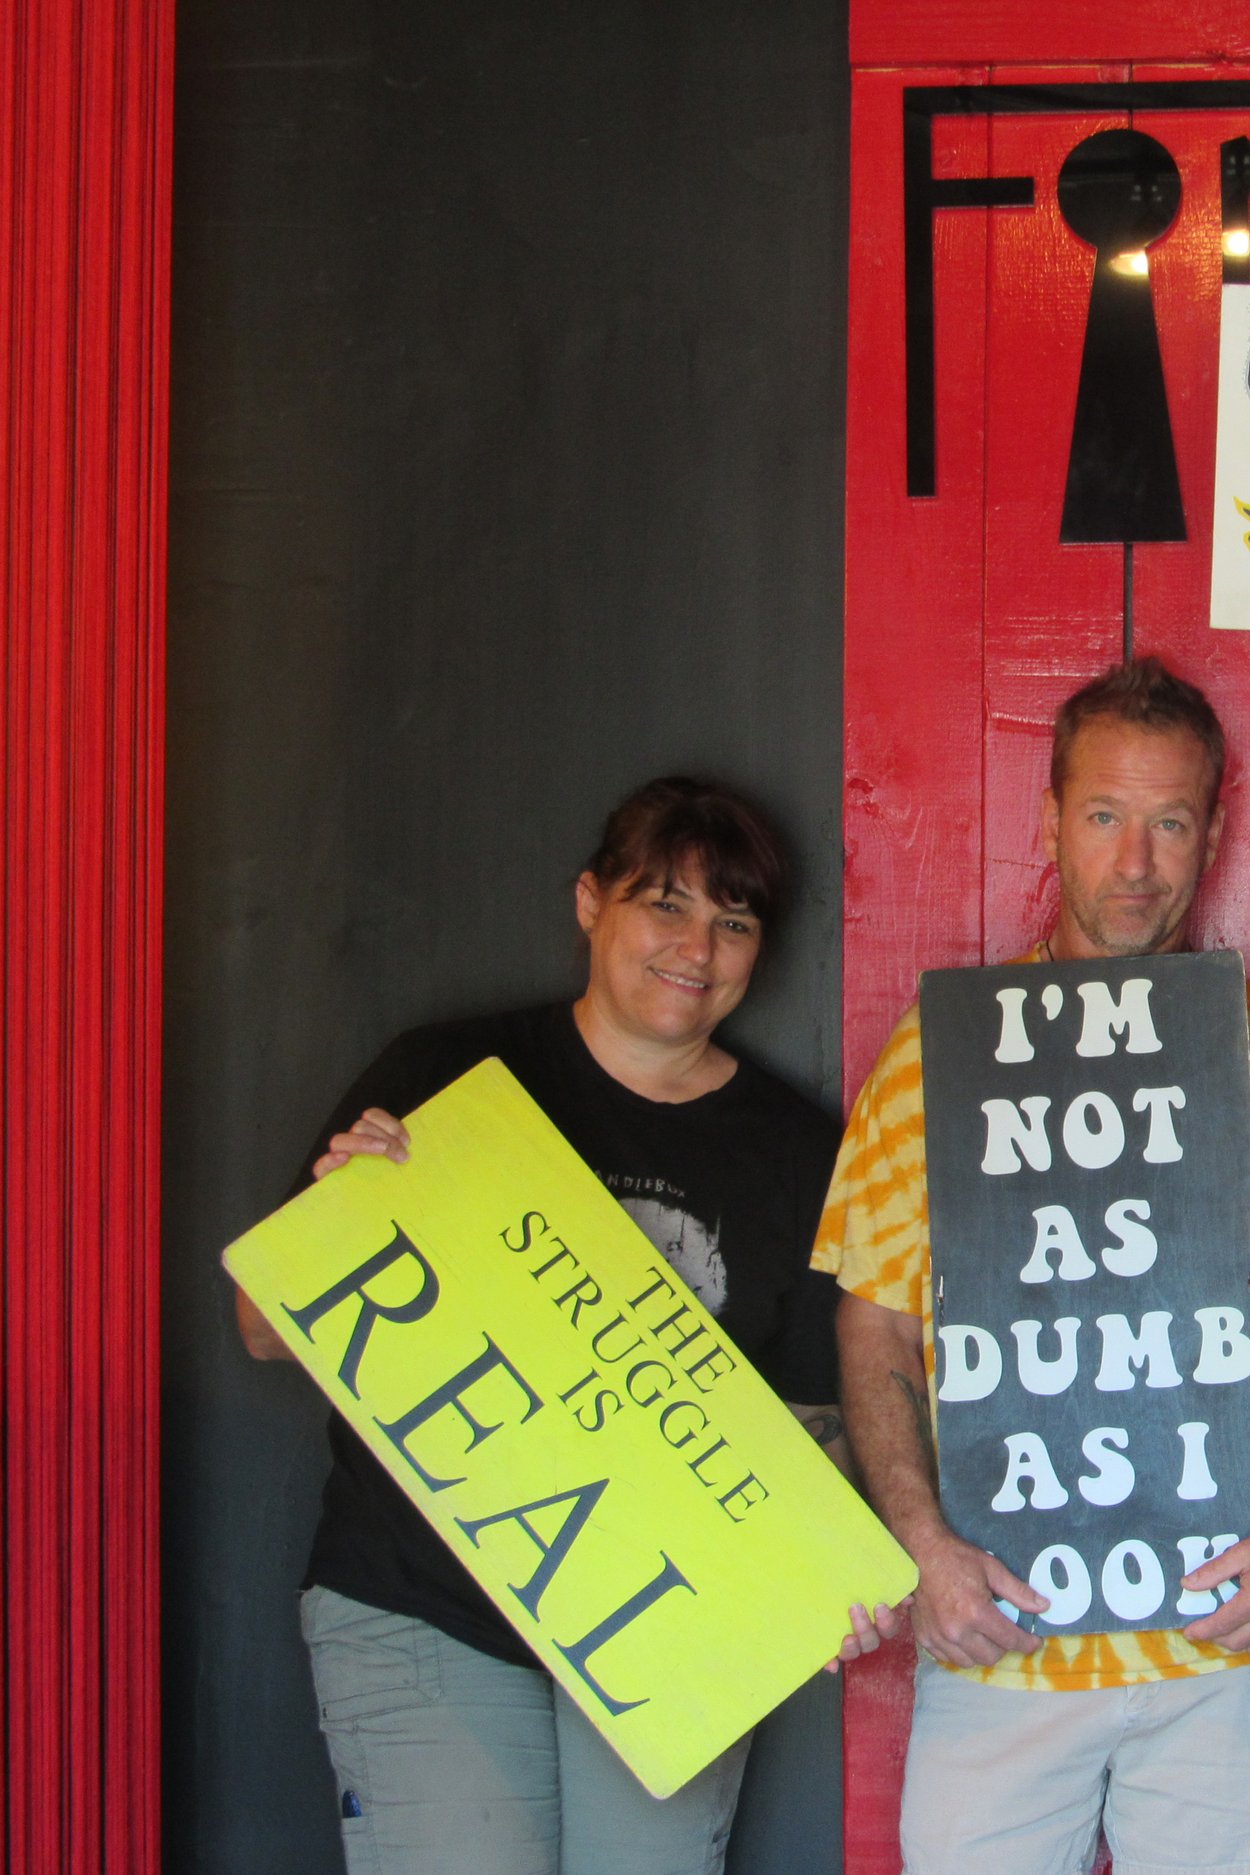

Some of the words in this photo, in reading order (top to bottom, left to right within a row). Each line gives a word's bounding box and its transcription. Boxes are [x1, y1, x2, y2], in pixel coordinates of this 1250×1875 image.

[994, 978, 1163, 1064] I'M
[980, 1085, 1186, 1175] NOT
[1019, 1199, 1159, 1284] AS
[499, 1211, 770, 1523] STRUGGLE
[626, 1266, 737, 1394] THE
[557, 1368, 626, 1433] IS
[280, 1218, 698, 1717] REAL
[991, 1426, 1135, 1513] AS
[1176, 1421, 1218, 1501] I
[986, 1533, 1240, 1626] OOK
